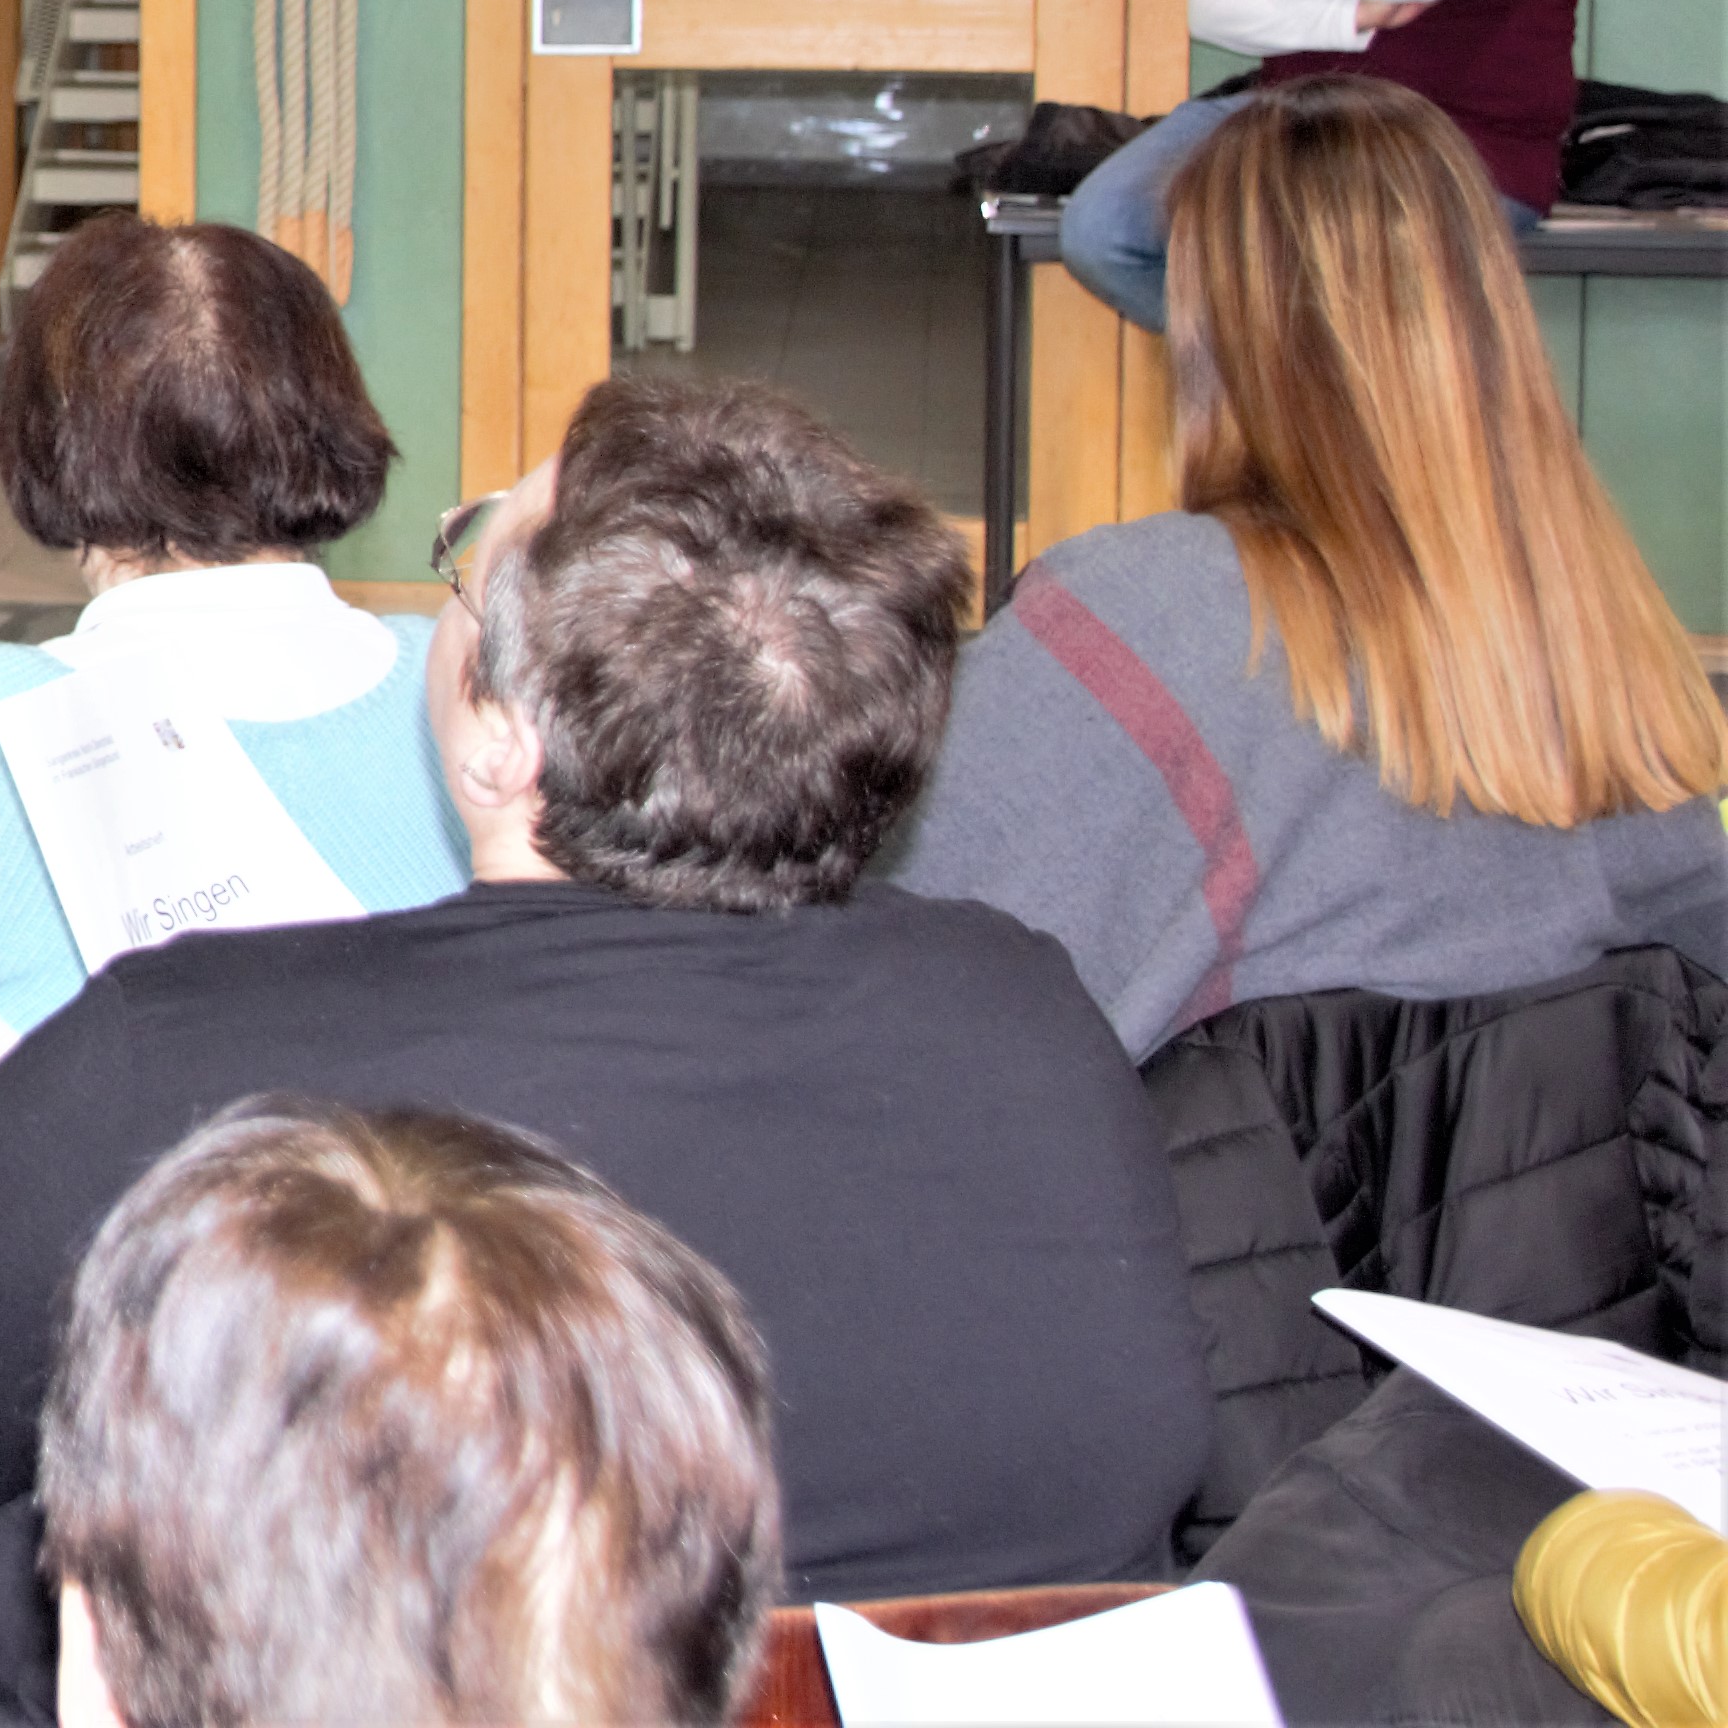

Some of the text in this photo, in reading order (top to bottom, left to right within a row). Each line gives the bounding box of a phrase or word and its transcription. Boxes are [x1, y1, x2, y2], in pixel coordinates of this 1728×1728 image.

[120, 874, 250, 947] Wir Singen
[1550, 1386, 1618, 1405] Wir
